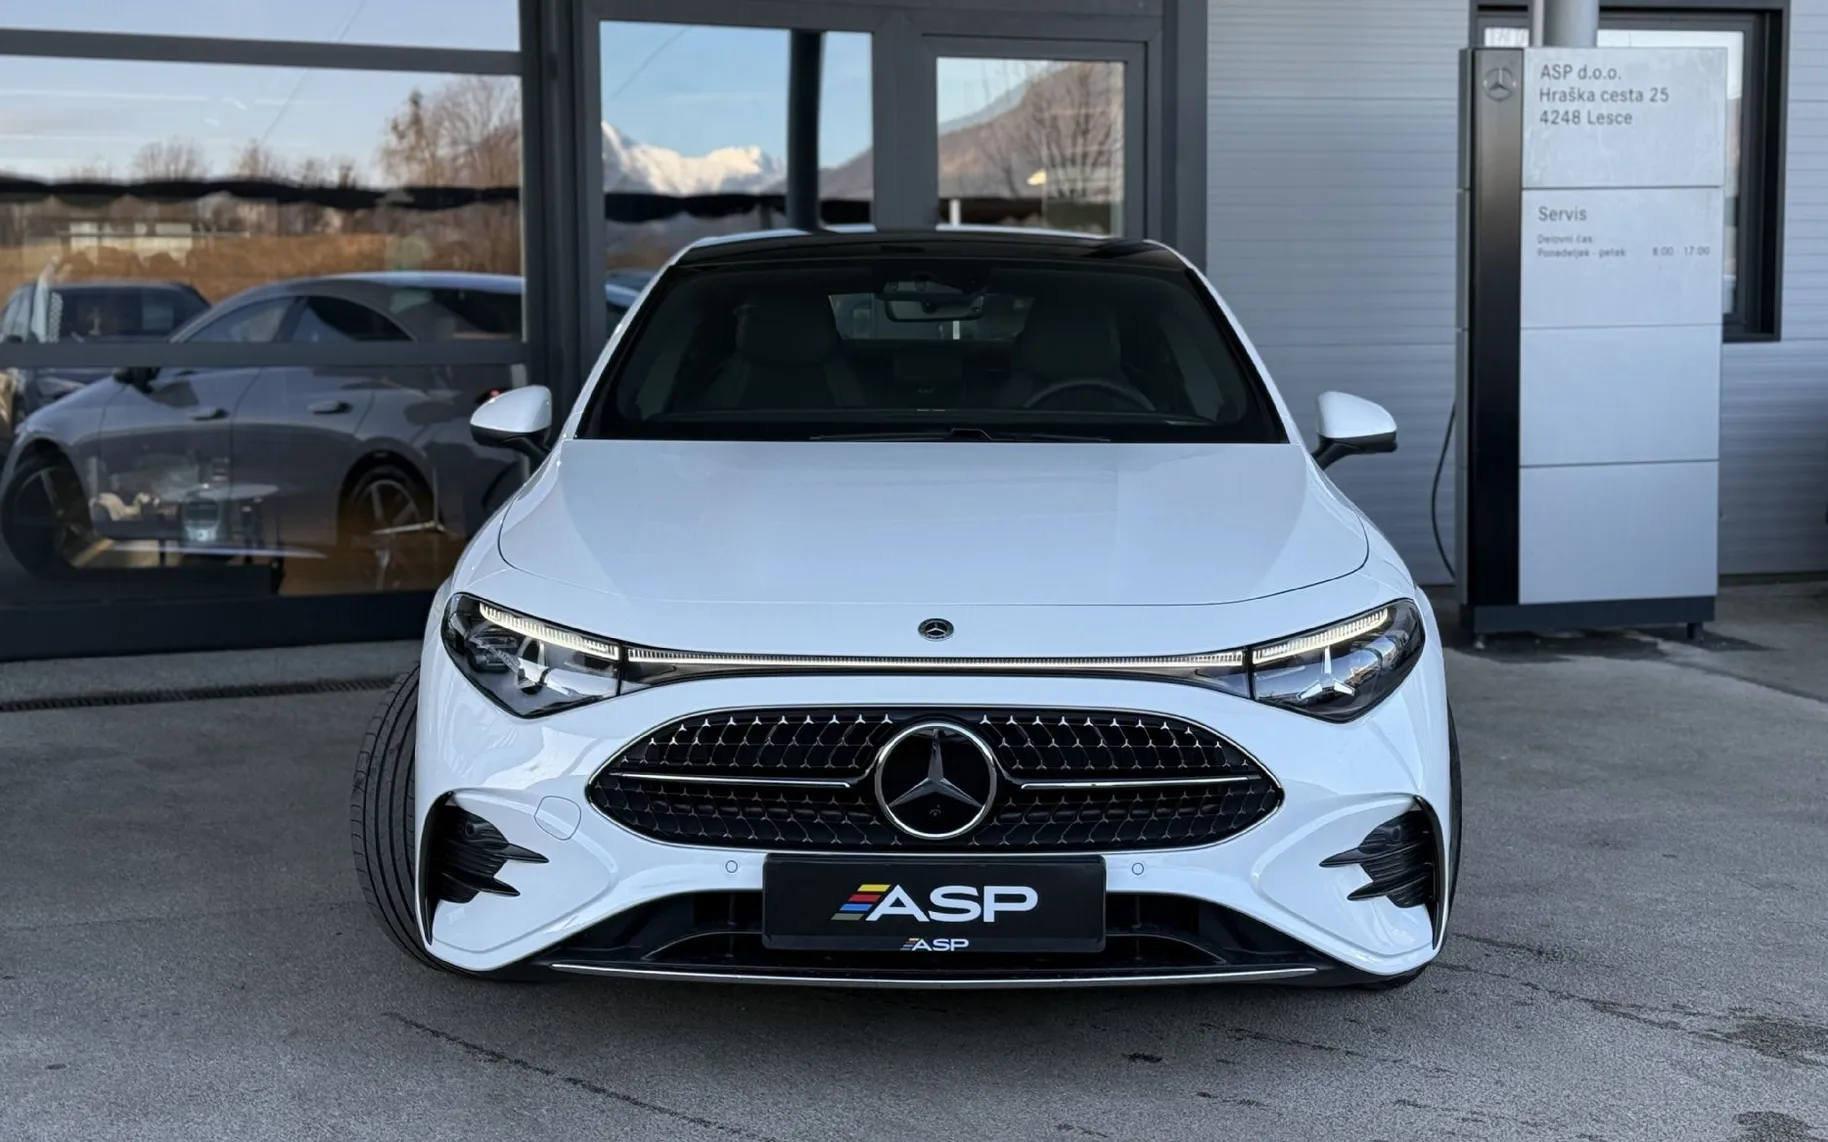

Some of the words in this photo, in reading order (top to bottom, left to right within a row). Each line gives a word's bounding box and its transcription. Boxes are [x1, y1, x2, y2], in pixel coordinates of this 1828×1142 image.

[1540, 64, 1572, 80] ASP
[1577, 64, 1621, 80] d.o.o.
[1539, 87, 1596, 102] Hraška
[1600, 88, 1643, 102] cesta
[1649, 87, 1669, 102] 25
[1539, 109, 1581, 125] 4248
[1587, 109, 1633, 125] Lesce
[1538, 206, 1587, 221] Servis
[865, 884, 1038, 922] ASP
[911, 938, 969, 951] ASP
